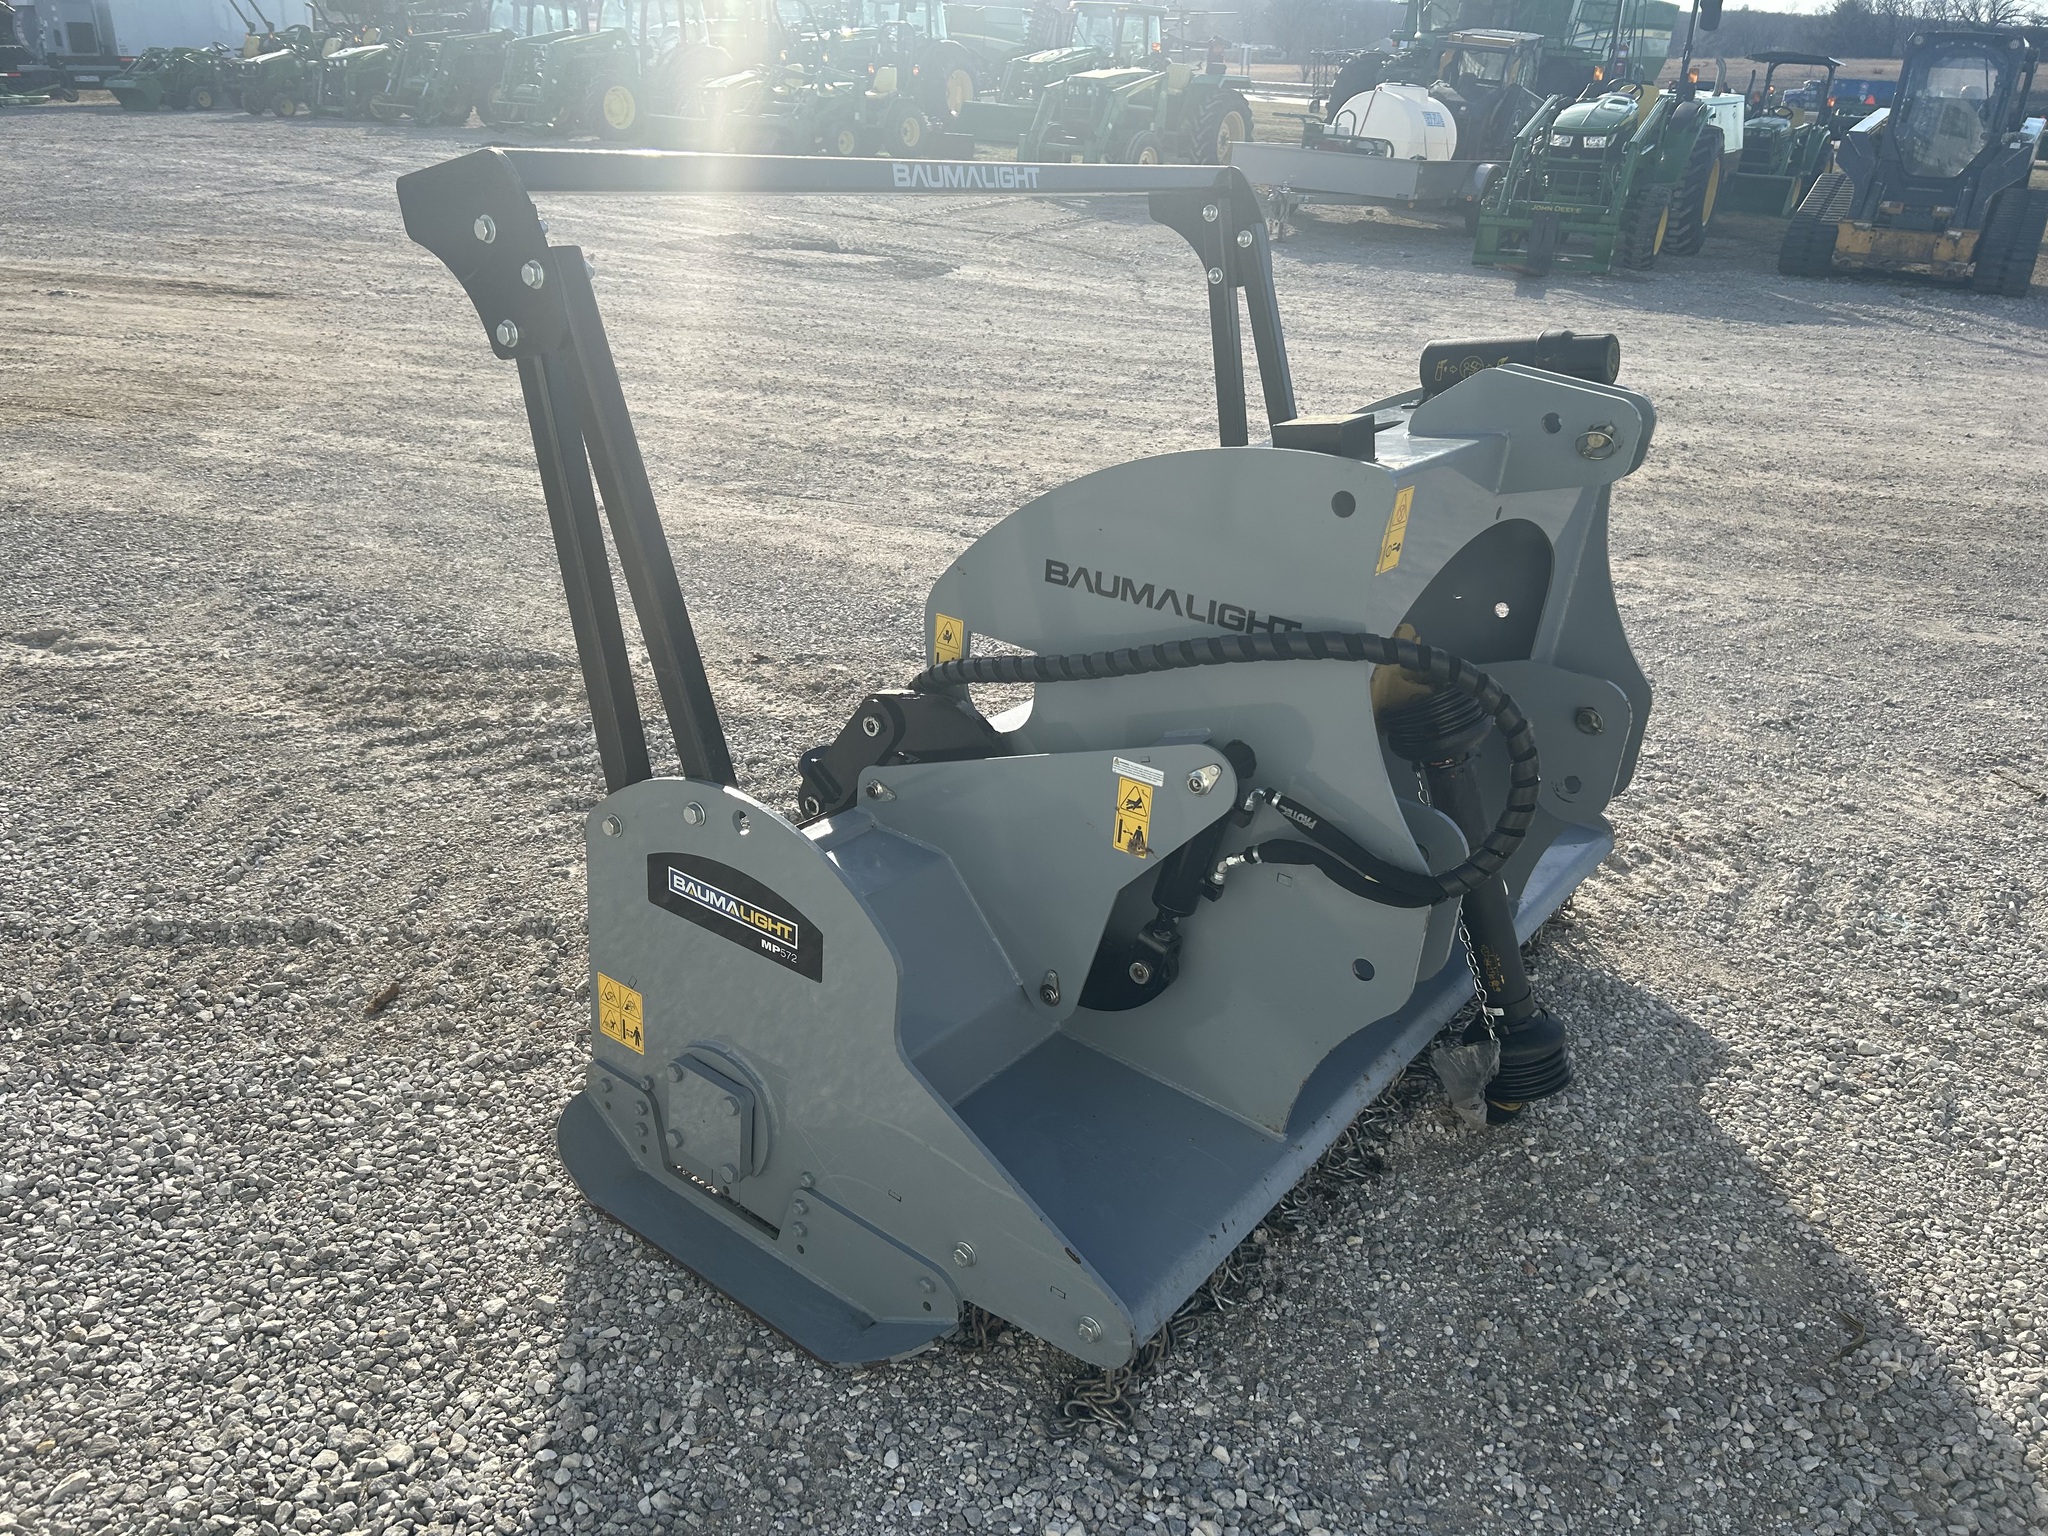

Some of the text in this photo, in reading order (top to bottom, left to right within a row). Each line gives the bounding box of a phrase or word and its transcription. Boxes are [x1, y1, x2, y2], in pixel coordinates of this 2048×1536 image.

[892, 163, 1040, 189] BAUMALIGHT
[1530, 204, 1553, 212] JOHN
[1044, 558, 1303, 635] BAUMALIGHT
[673, 873, 794, 941] BAUMALIGHT
[761, 938, 798, 964] MP572
